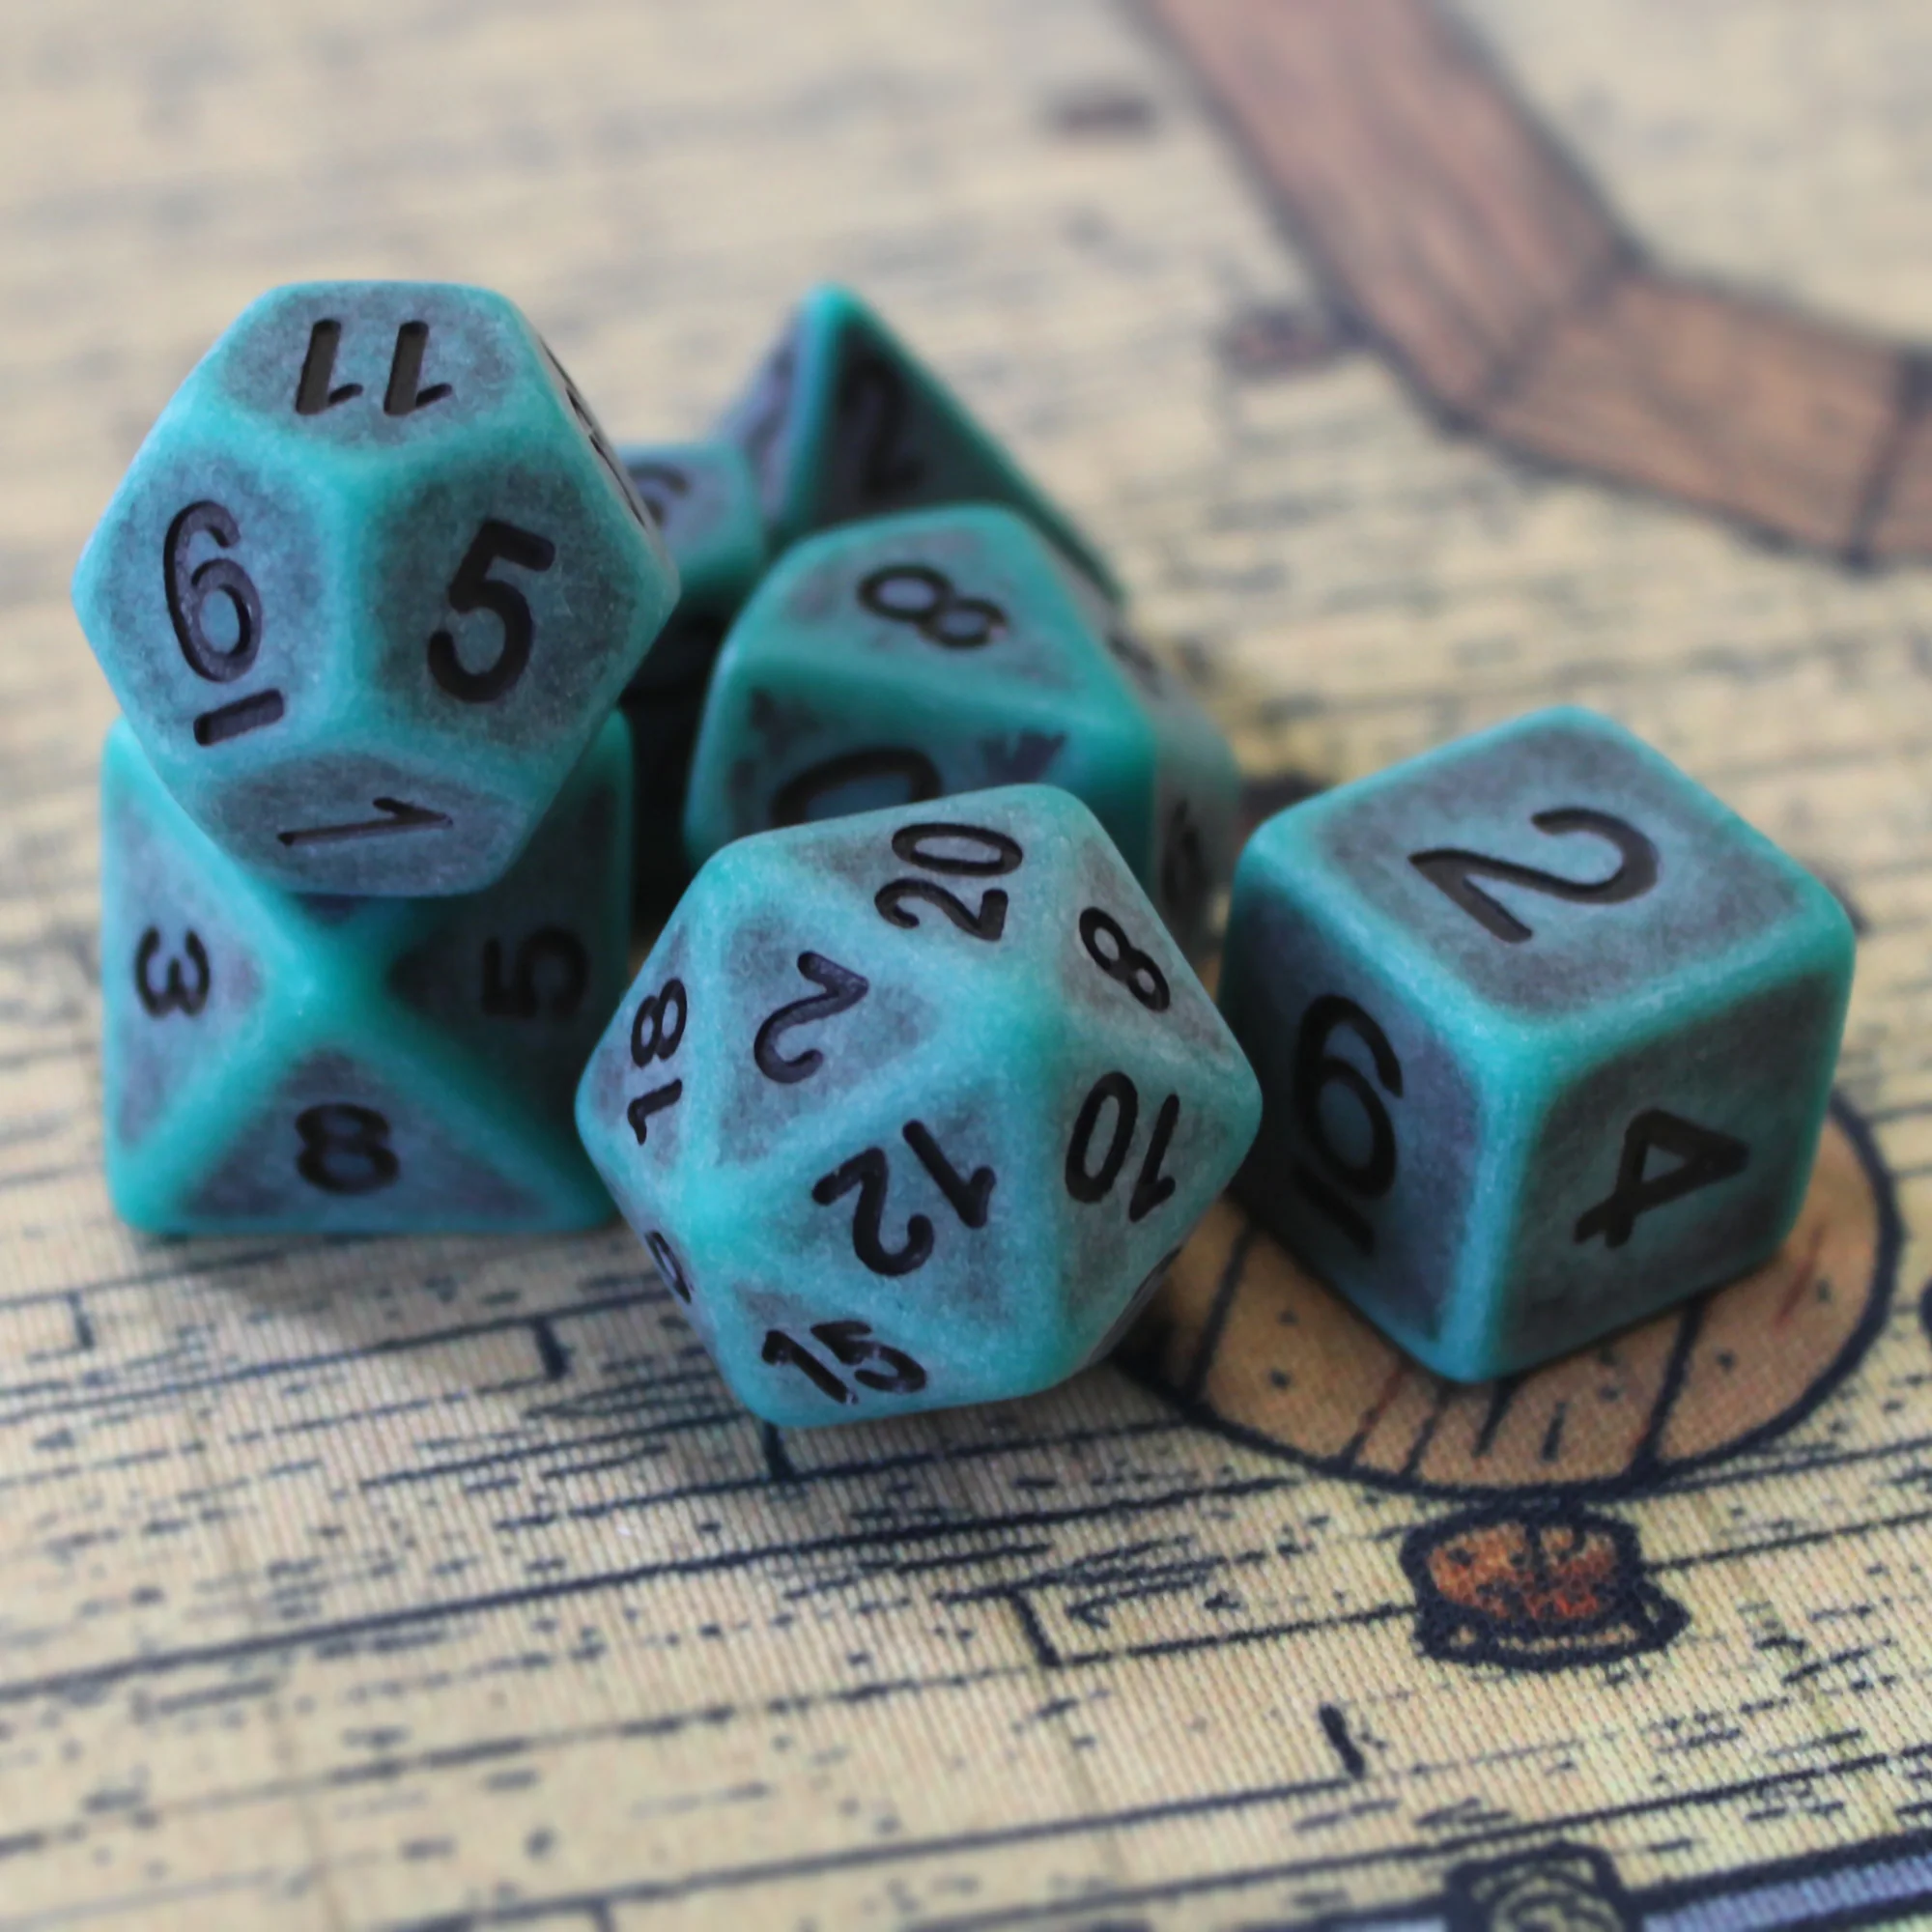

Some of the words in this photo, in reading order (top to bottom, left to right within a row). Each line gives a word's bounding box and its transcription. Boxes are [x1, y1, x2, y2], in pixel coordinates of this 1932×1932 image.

[295, 319, 452, 415] 11
[163, 499, 284, 746] 6
[427, 519, 555, 704] 5
[858, 564, 1009, 650] 8
[277, 797, 454, 845] 1
[874, 822, 1023, 941] 20
[1407, 808, 1660, 944] 2
[134, 925, 211, 1018] 3
[481, 924, 589, 1020] 5
[753, 951, 868, 1084] 2
[1078, 907, 1170, 1012] 8
[627, 978, 687, 1146] 18
[1293, 994, 1404, 1254] 6
[295, 1101, 400, 1196] 8
[811, 1120, 995, 1277] 12
[1065, 1070, 1180, 1222] 10
[1573, 1107, 1749, 1249] 4
[761, 1320, 926, 1406] 15
